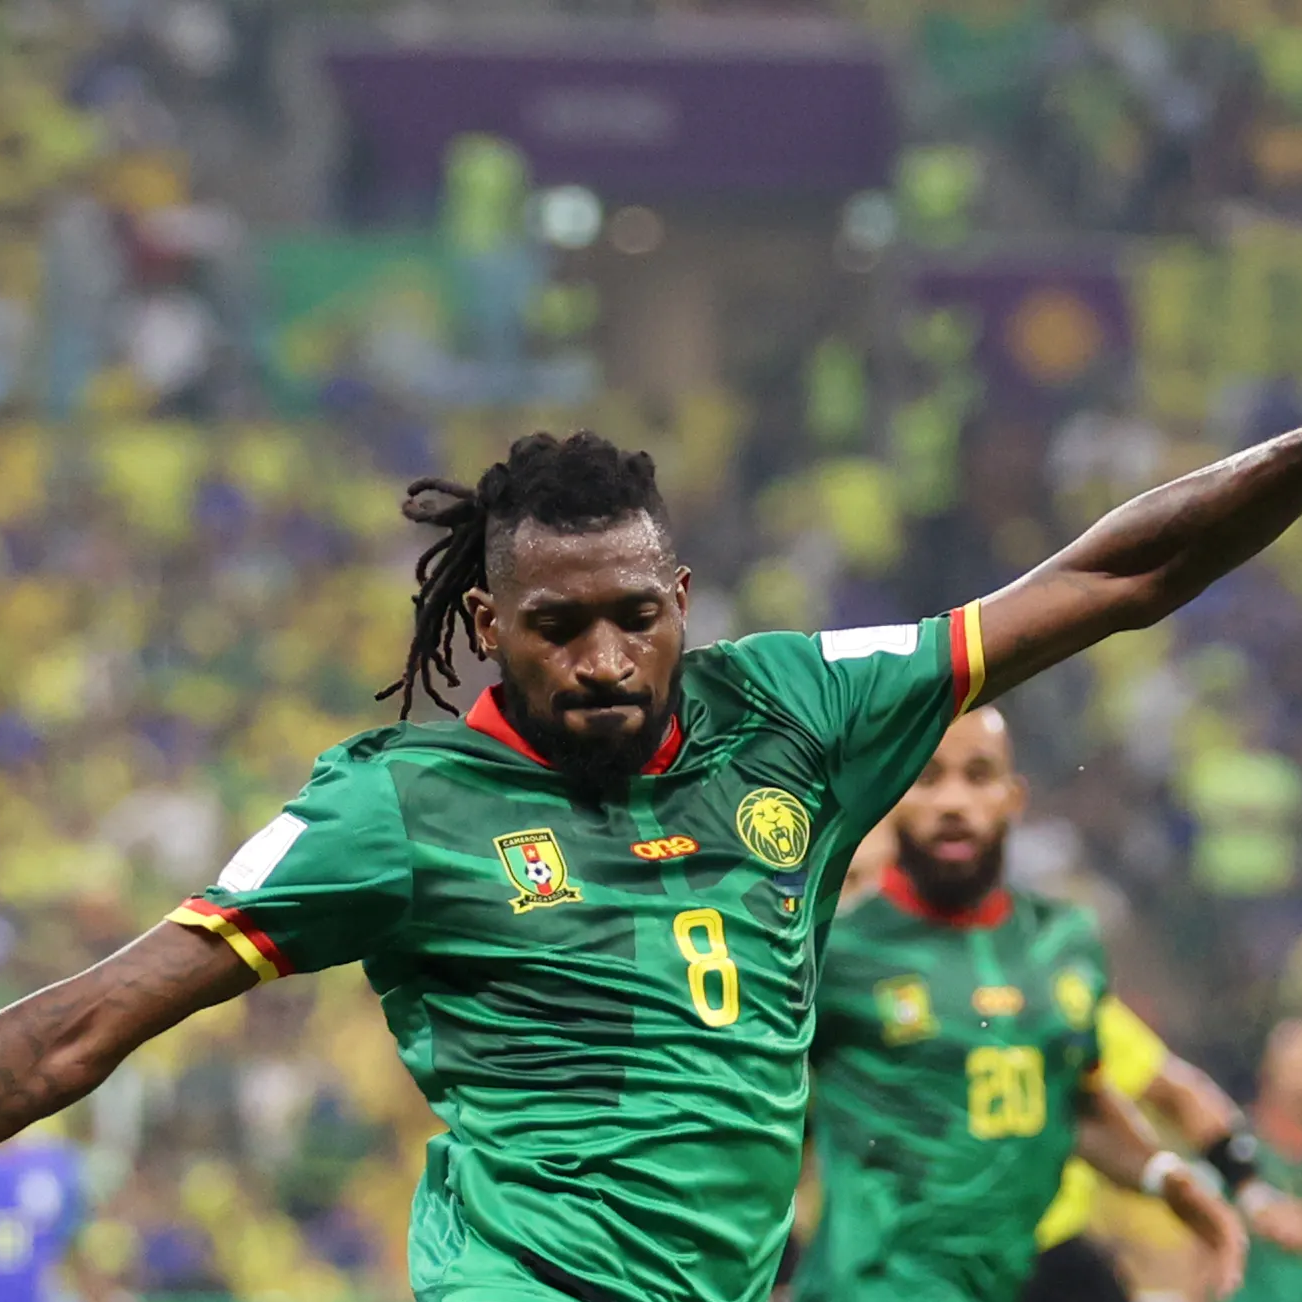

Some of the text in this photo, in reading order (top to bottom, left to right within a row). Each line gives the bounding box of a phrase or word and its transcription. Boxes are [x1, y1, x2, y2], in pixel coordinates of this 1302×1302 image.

[502, 834, 548, 848] CAMEROUN
[632, 835, 698, 860] one
[673, 907, 740, 1028] 8
[966, 1045, 1046, 1139] 20
